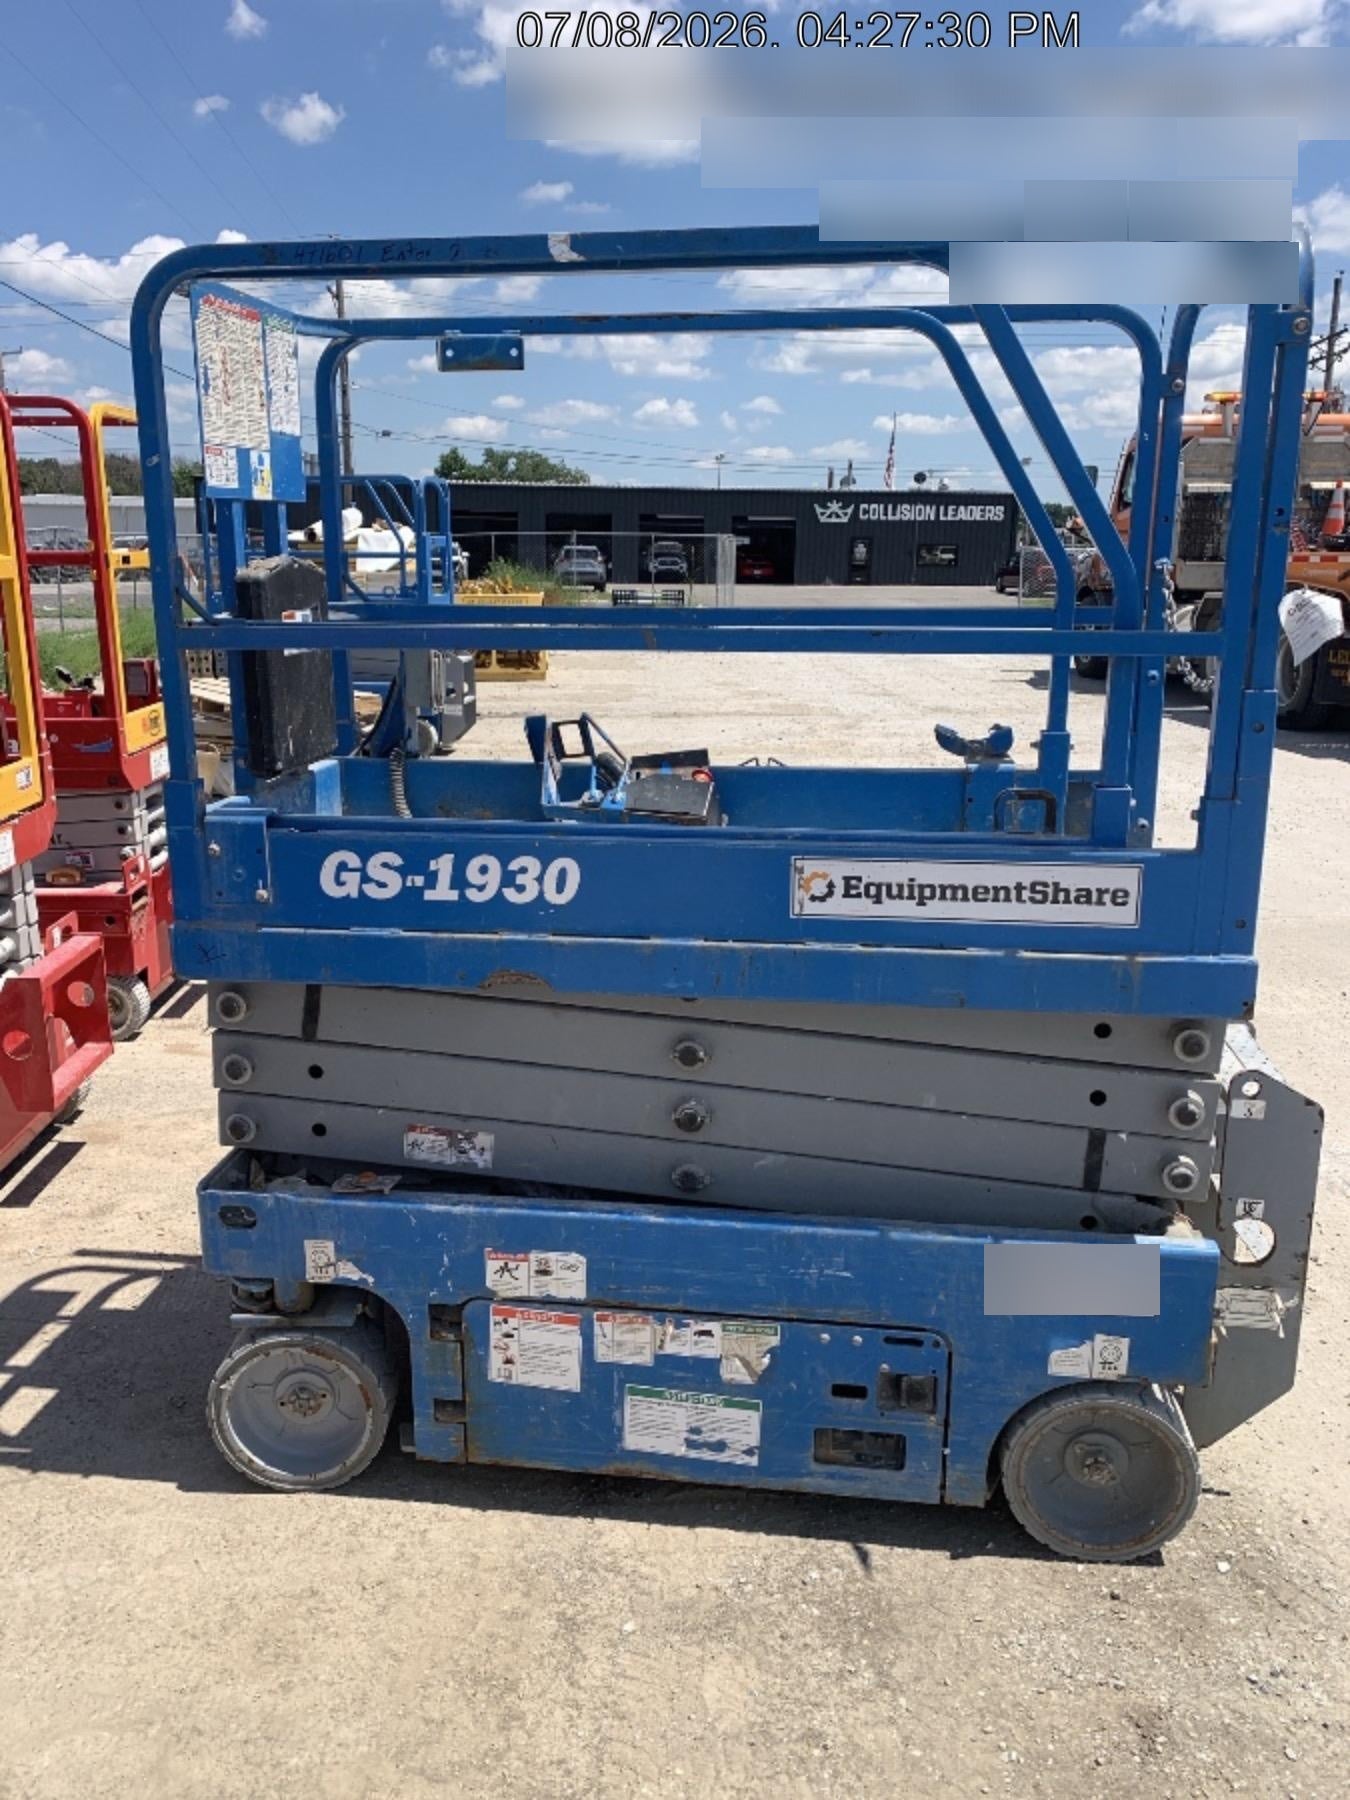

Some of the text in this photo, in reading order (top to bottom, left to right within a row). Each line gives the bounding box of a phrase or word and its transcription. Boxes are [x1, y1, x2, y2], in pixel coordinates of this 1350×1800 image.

[859, 503, 1005, 521] COLLISION LEADERS
[319, 850, 581, 905] GS-1930
[841, 875, 1131, 907] EquipmentShare
